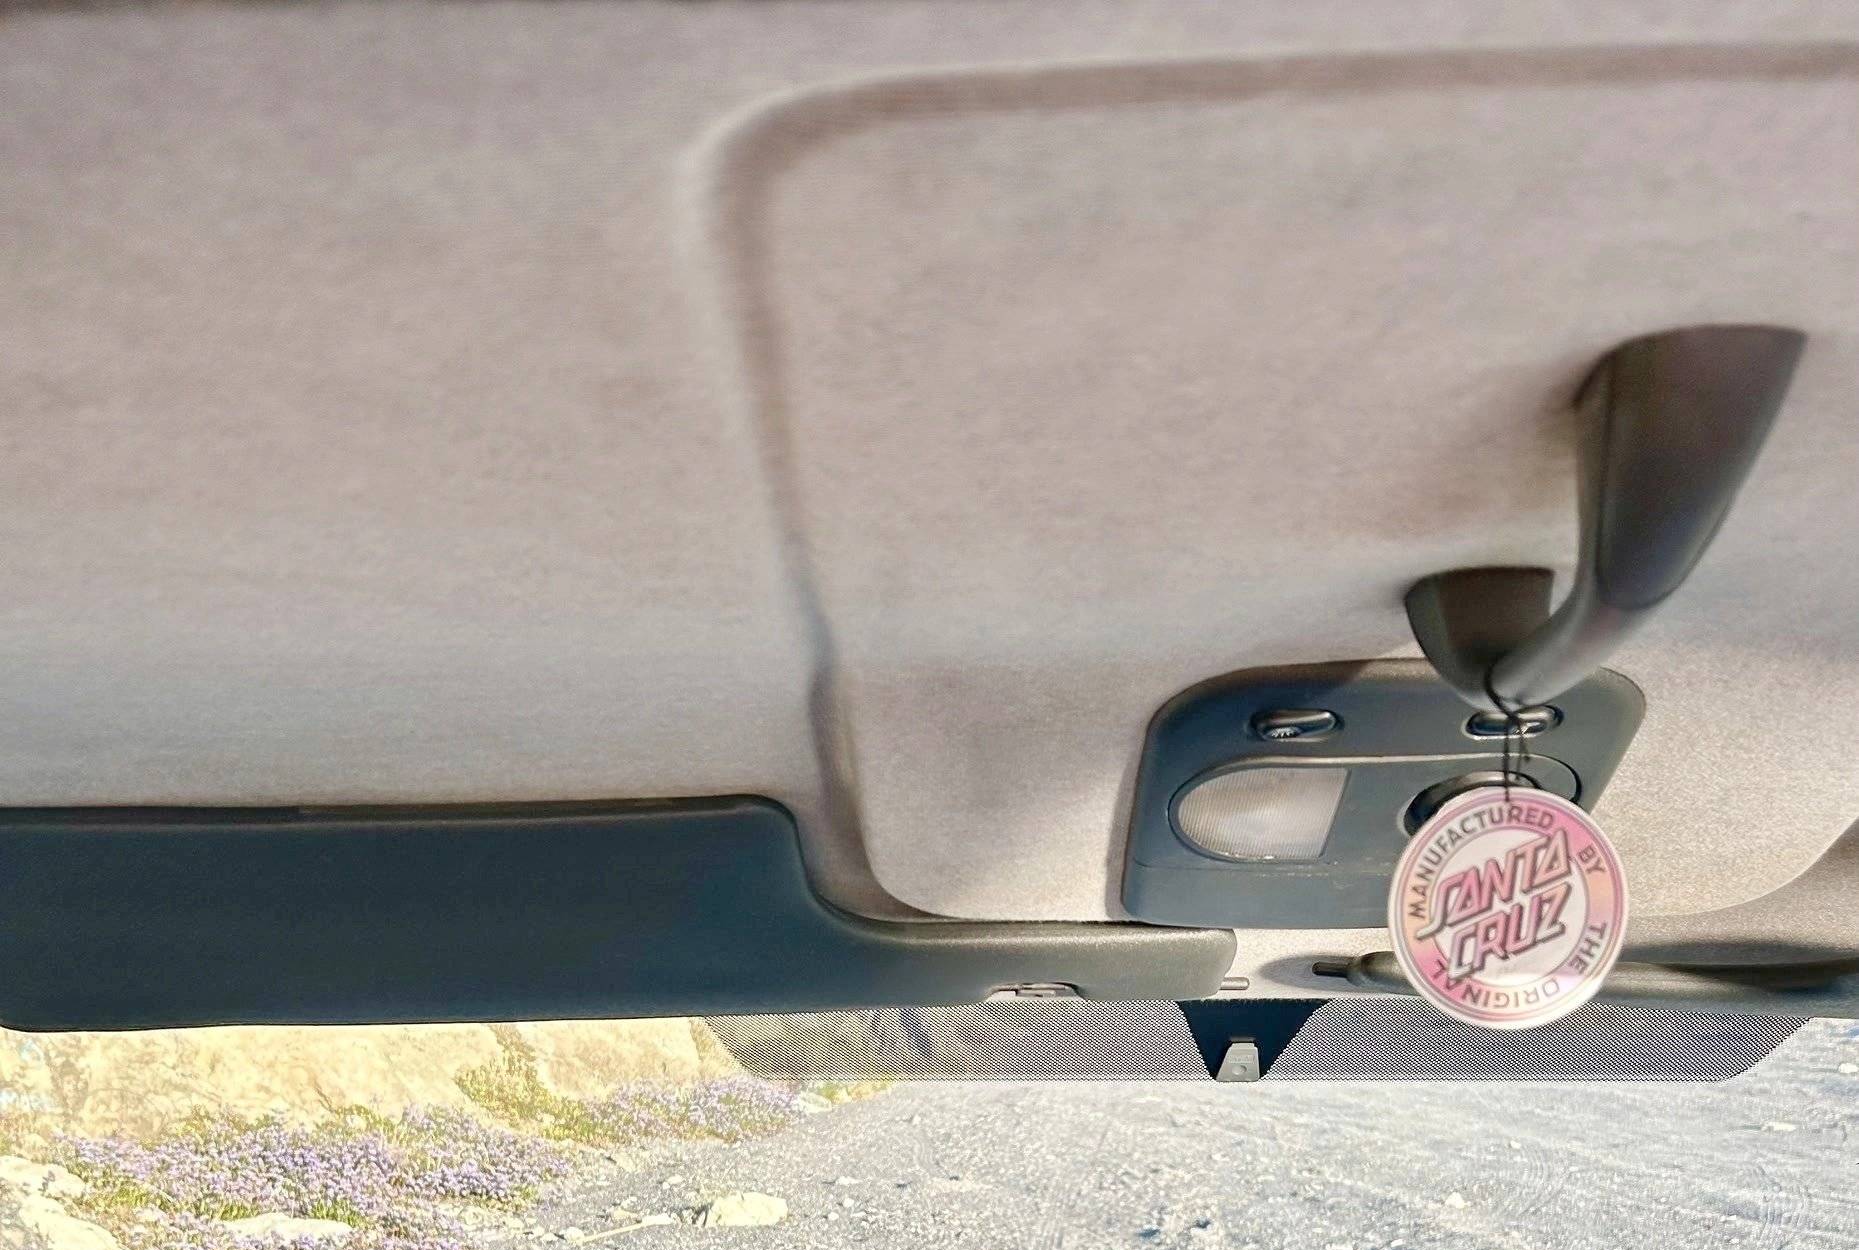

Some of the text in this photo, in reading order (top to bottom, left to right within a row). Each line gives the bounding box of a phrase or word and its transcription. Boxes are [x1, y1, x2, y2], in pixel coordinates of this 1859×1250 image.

[1409, 805, 1555, 918] MANUFACTURED
[1416, 828, 1572, 941] SANTA
[1577, 845, 1606, 874] BY
[1449, 881, 1572, 981] CRUZ
[1567, 922, 1607, 974] THE
